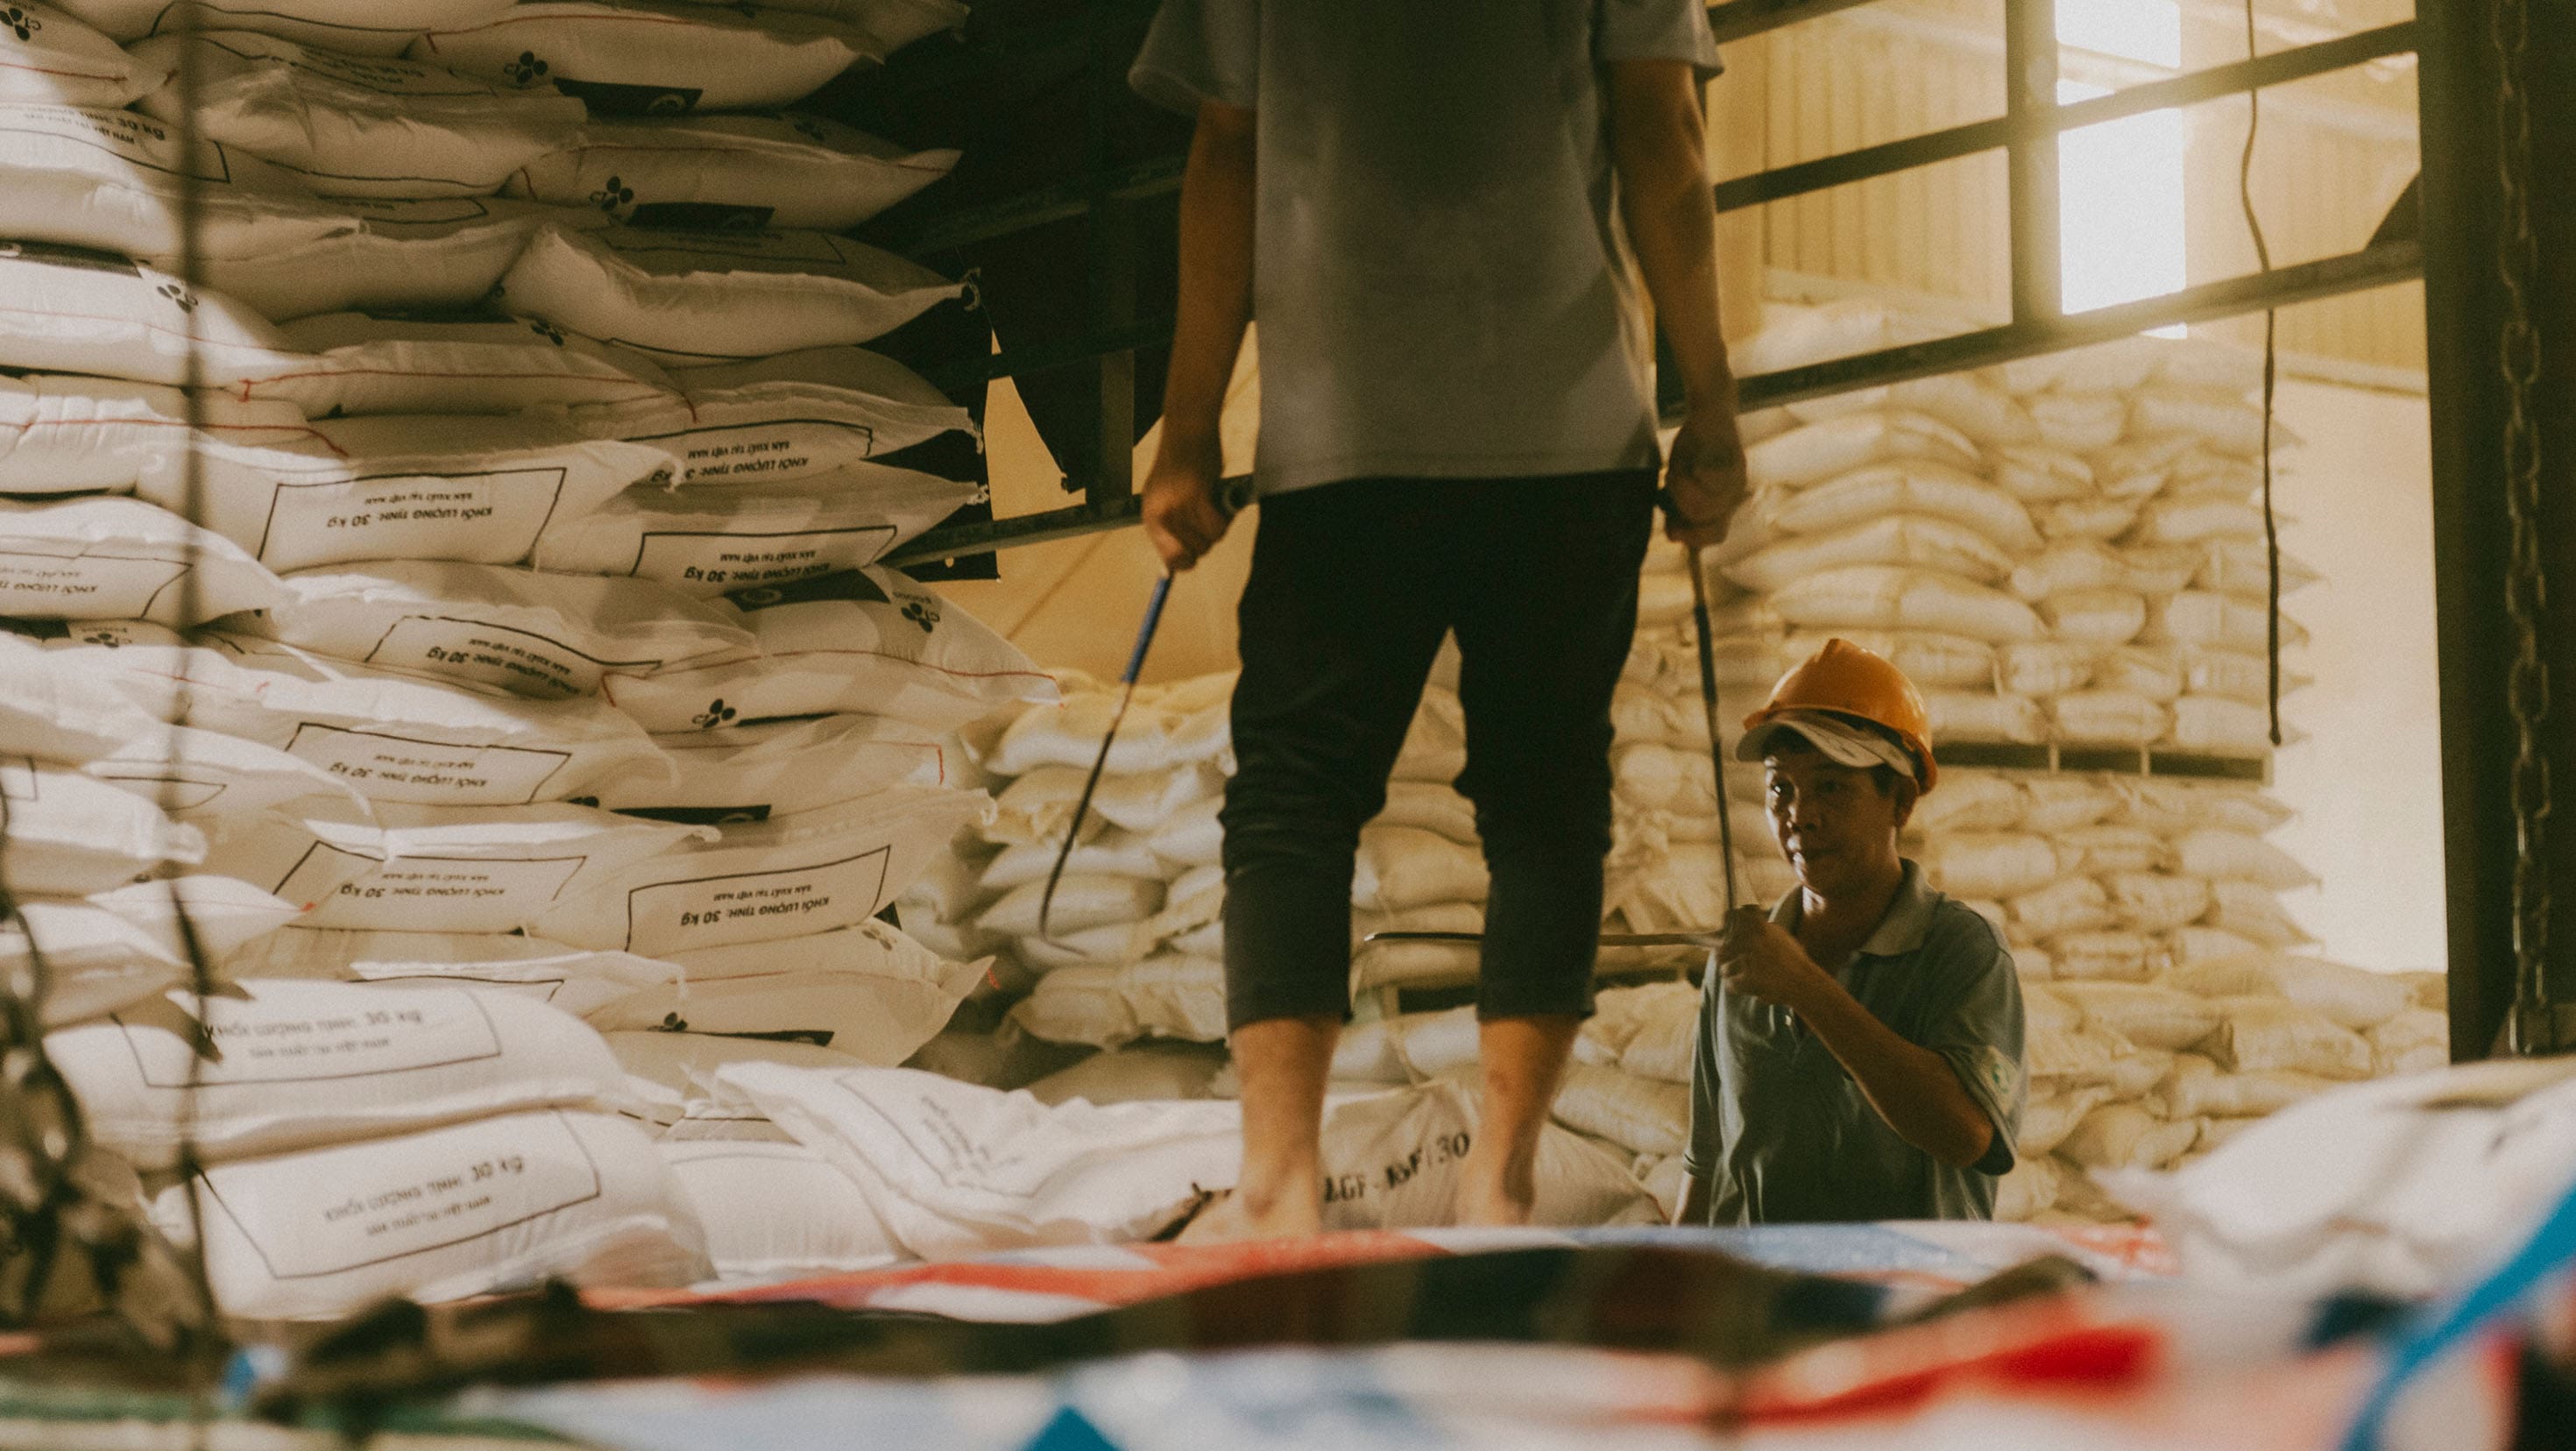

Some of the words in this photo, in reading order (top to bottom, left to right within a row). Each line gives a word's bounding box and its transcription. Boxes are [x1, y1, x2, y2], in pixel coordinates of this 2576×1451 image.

[688, 449, 710, 459] NAM
[327, 516, 346, 529] kg
[351, 514, 371, 527] 30
[759, 902, 800, 916] LƯỢNG
[802, 896, 830, 914] KHỐI
[681, 912, 699, 926] kg
[703, 910, 721, 924] 30
[366, 1010, 390, 1024] 30
[471, 1161, 494, 1182] 30
[499, 1155, 524, 1174] kg
